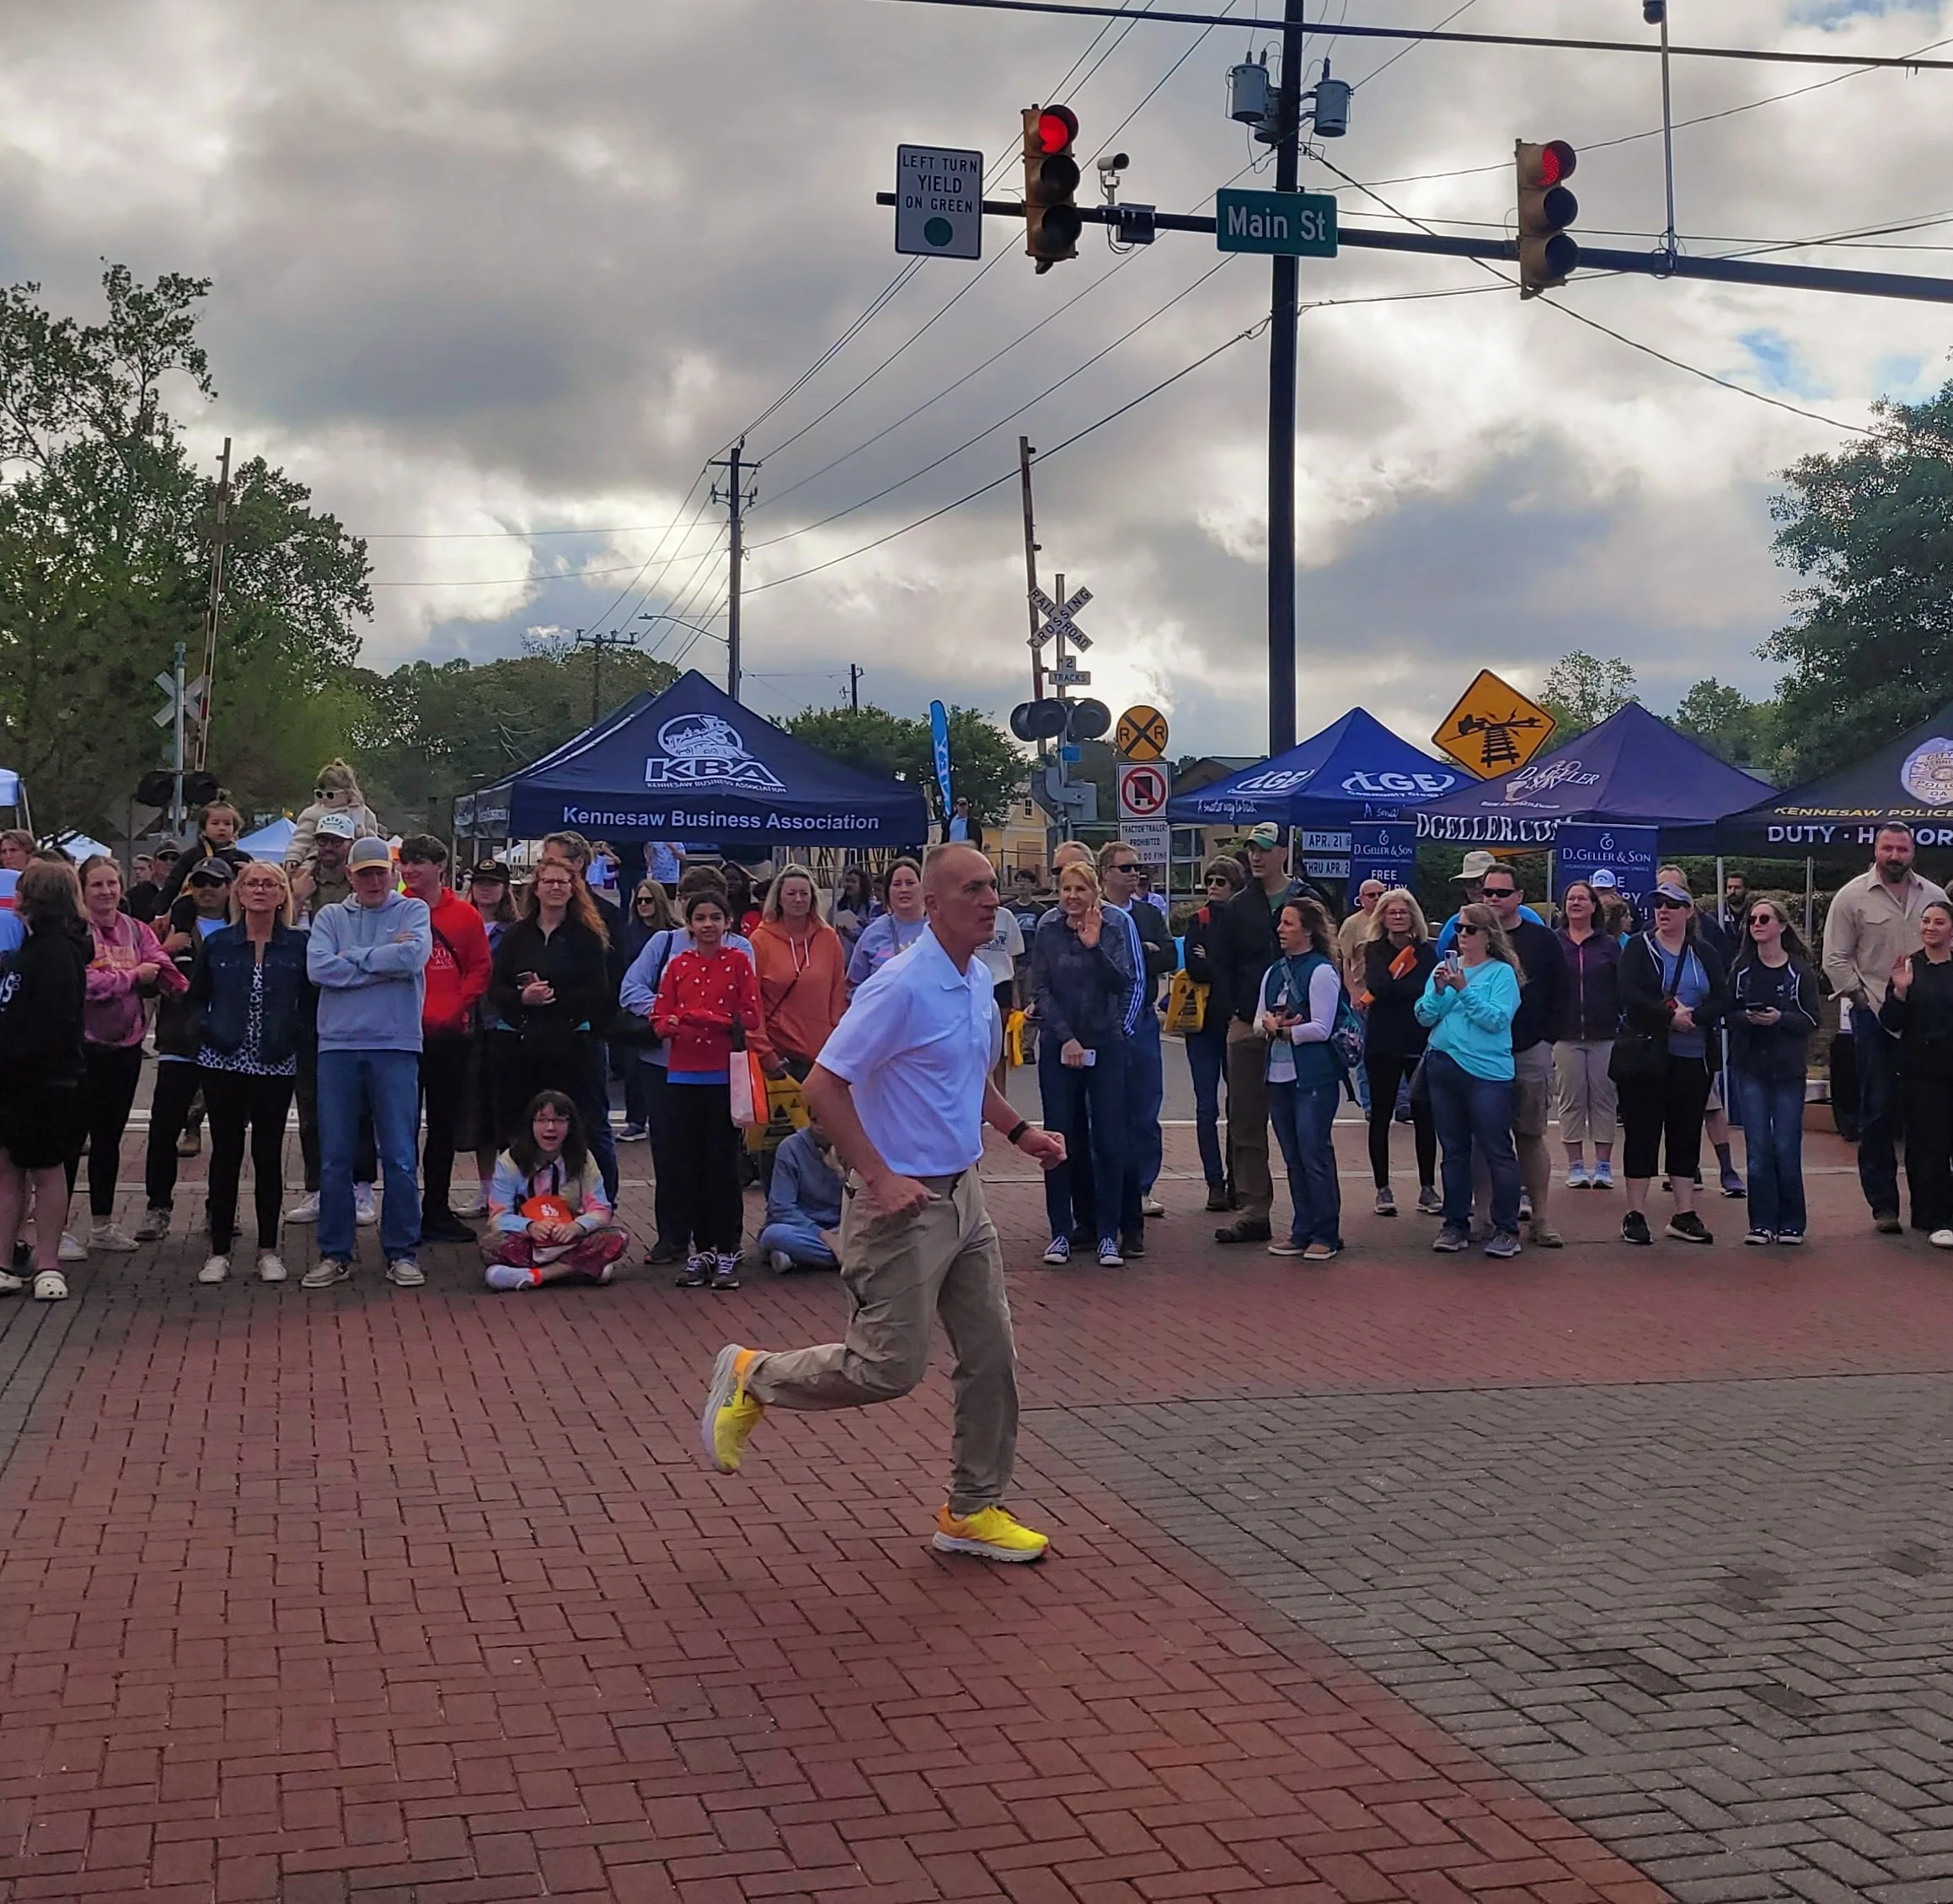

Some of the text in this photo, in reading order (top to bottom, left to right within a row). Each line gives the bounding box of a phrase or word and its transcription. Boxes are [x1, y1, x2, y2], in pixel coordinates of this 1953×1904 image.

[903, 155, 977, 174] LEFT TURN
[918, 174, 962, 194] YIELD
[906, 195, 973, 213] ON GREEN
[1228, 206, 1326, 242] Main St
[1030, 590, 1089, 649] CROSSING
[1066, 658, 1073, 668] 2
[1053, 673, 1087, 682] TRACKS
[1120, 725, 1165, 741] R R
[645, 757, 785, 787] KBA
[563, 806, 880, 831] Kennesaw Business Association
[1774, 806, 1884, 817] KENNESAW
[1308, 835, 1330, 848] APR.
[1334, 835, 1342, 848] 21
[1768, 826, 1836, 843] DUTY
[1390, 846, 1399, 858] &
[1616, 851, 1629, 864] &
[1306, 862, 1324, 874] THRU
[1325, 862, 1343, 874] APR.
[1371, 869, 1398, 880] FREE
